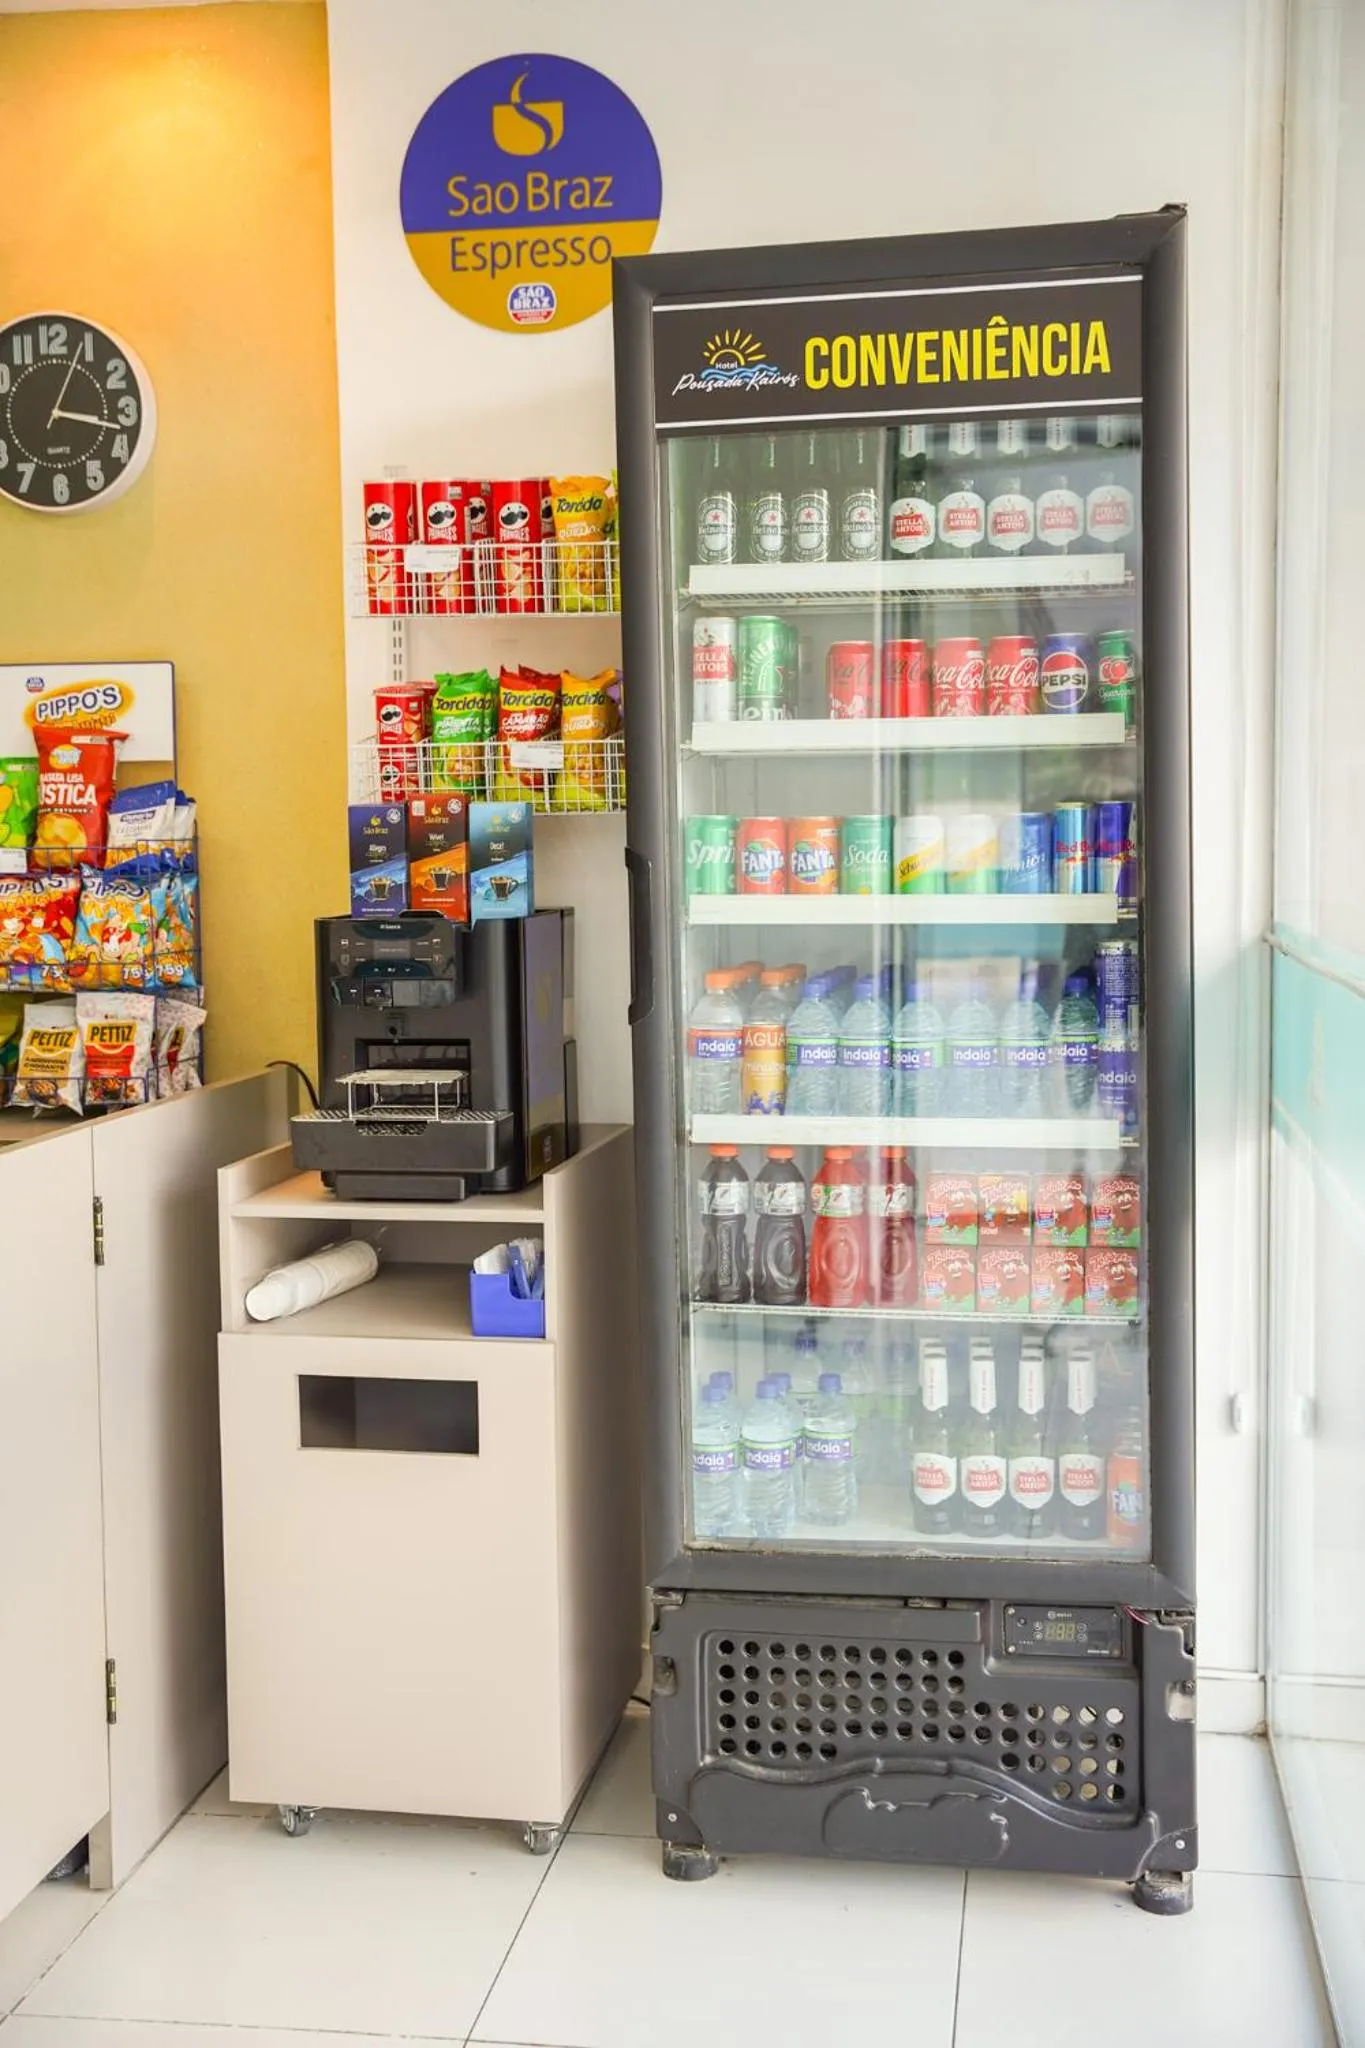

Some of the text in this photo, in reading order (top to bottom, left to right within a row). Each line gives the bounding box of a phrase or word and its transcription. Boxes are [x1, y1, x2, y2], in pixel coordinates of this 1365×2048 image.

[526, 171, 614, 212] Braz
[451, 235, 613, 280] Espresso
[512, 296, 551, 311] BRAZ
[13, 334, 33, 365] 11
[38, 324, 68, 355] 12
[84, 332, 94, 362] 1
[804, 315, 1111, 390] CONVENIÊNCIA
[106, 358, 127, 390] 2
[715, 361, 738, 370] Hotel
[117, 395, 138, 427] 3
[111, 433, 129, 464] 4
[16, 462, 36, 493] 7
[52, 473, 70, 505] 6
[86, 460, 105, 491] 5
[1042, 671, 1086, 687] PEPSI
[37, 686, 119, 718] PIPPO'S
[844, 844, 889, 866] Soda
